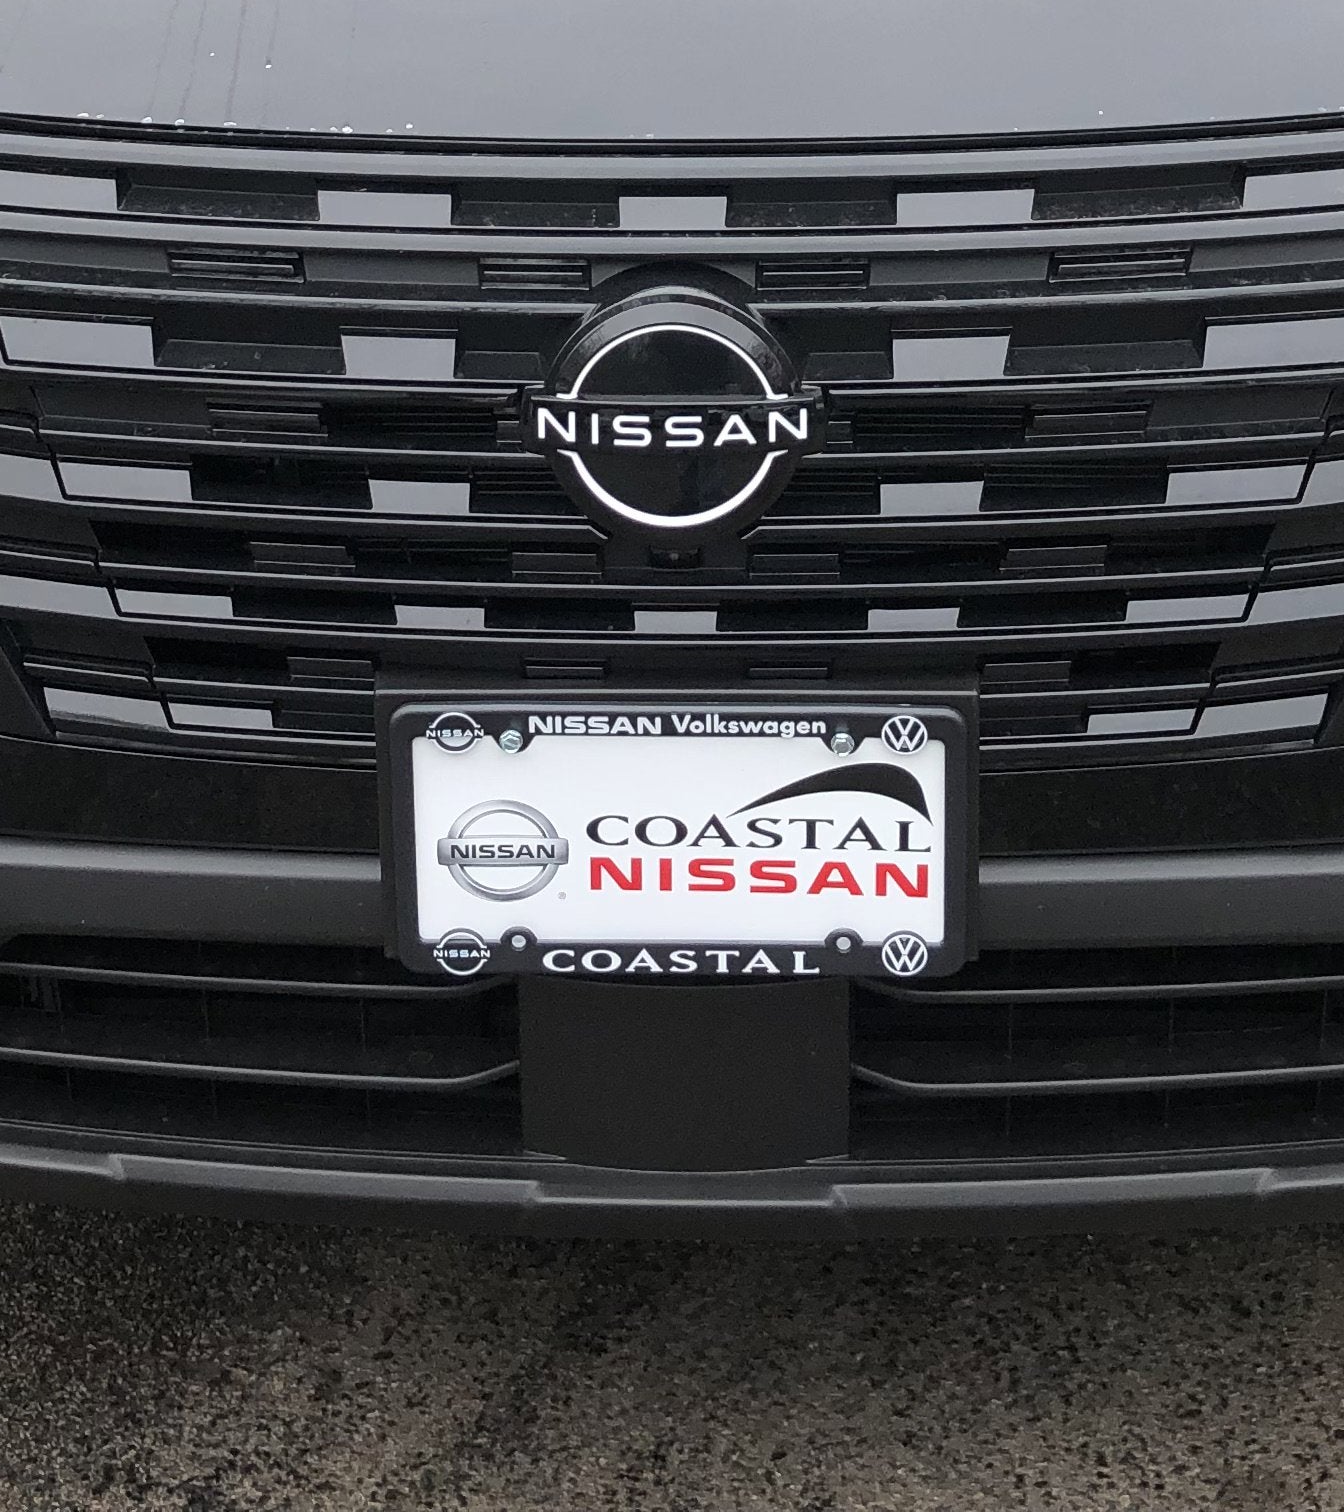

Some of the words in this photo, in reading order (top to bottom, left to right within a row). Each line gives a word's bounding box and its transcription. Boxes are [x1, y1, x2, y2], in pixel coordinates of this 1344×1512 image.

[537, 407, 808, 448] NISSAN
[425, 728, 484, 738] NISSAN
[528, 716, 662, 735] NISSAN
[671, 714, 827, 737] Volkswagen
[586, 814, 932, 852] COASTAL
[450, 844, 555, 859] NISSAN
[590, 858, 928, 897] NISSAN
[433, 949, 491, 958] NISSAN
[542, 949, 820, 974] COASTAL
